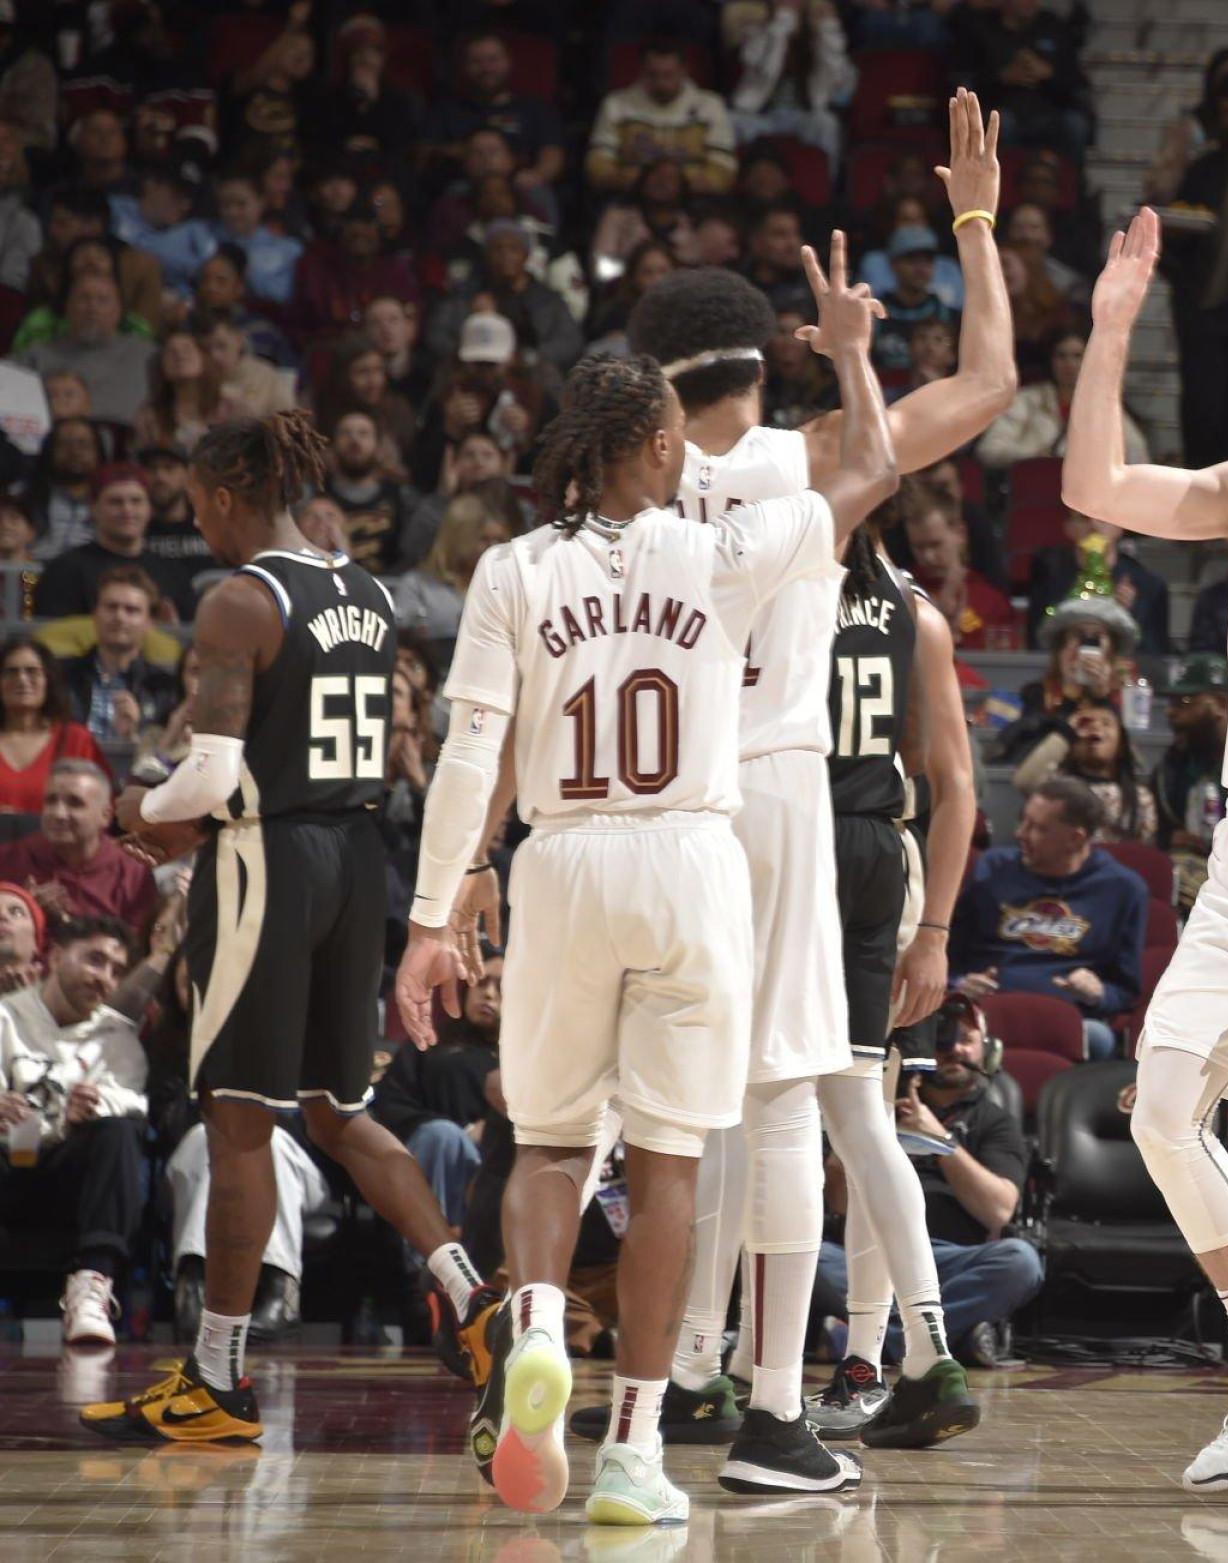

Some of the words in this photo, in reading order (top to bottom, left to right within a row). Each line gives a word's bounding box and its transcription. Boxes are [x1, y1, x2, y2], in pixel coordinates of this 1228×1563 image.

[307, 605, 388, 653] WRIGHT
[538, 592, 706, 658] GARLAND
[309, 676, 386, 779] 55
[559, 668, 679, 800] 10
[837, 657, 893, 756] 12
